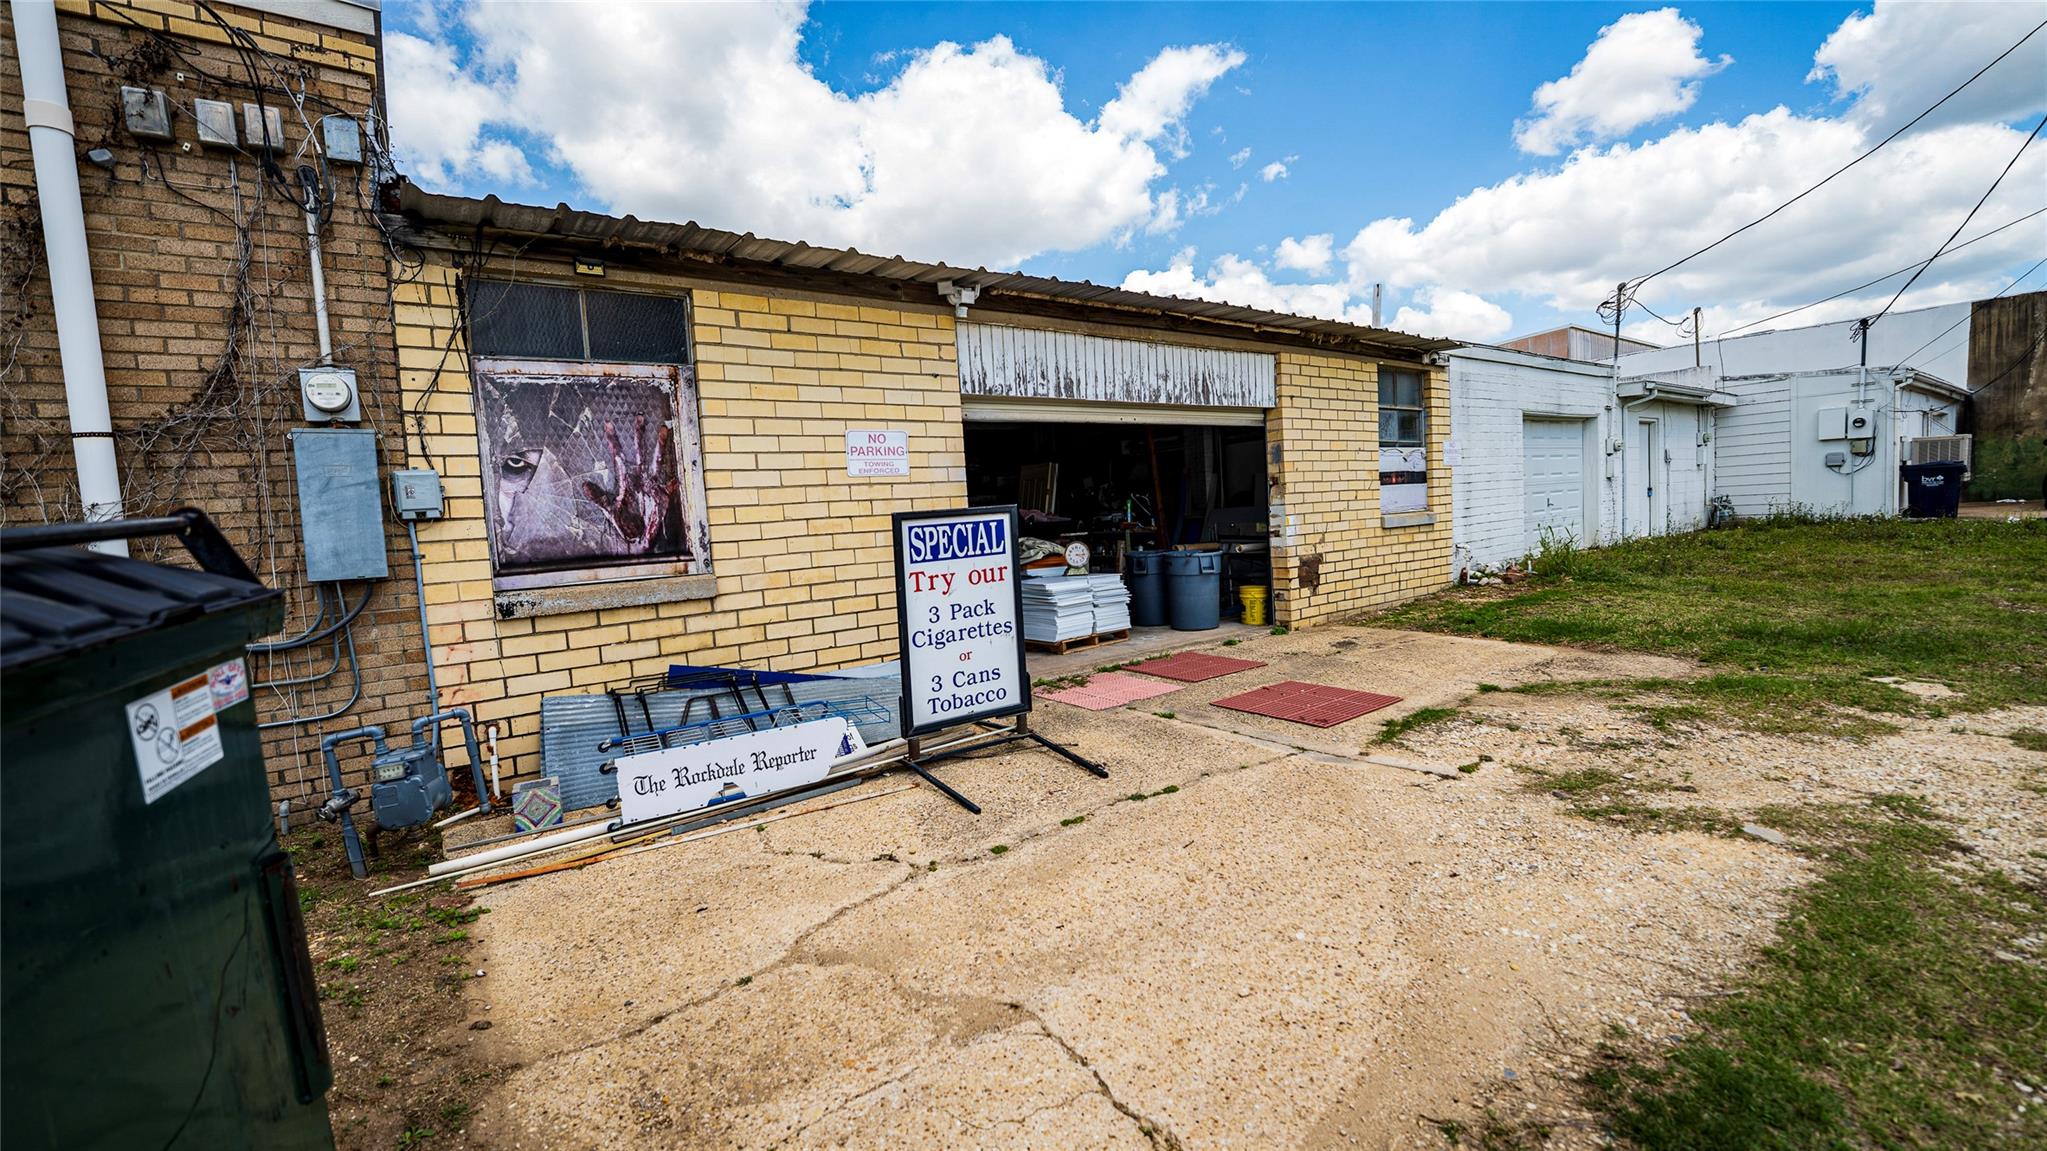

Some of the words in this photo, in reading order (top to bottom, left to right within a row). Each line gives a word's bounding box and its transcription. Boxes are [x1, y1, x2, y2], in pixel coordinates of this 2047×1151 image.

[850, 446, 905, 456] PARKING
[868, 433, 887, 444] NO
[910, 521, 1004, 561] SPECIAL
[908, 570, 956, 595] Try
[968, 565, 1008, 585] our
[928, 606, 940, 624] 3
[950, 599, 996, 620] Pack
[912, 620, 1013, 650] Cigarettes
[959, 650, 973, 661] or
[931, 675, 943, 692] 3
[952, 667, 1001, 688] Cans
[927, 687, 1007, 715] Tobacco
[633, 774, 667, 797] The
[671, 758, 746, 789] Rockdale
[750, 746, 818, 772] Reporter
